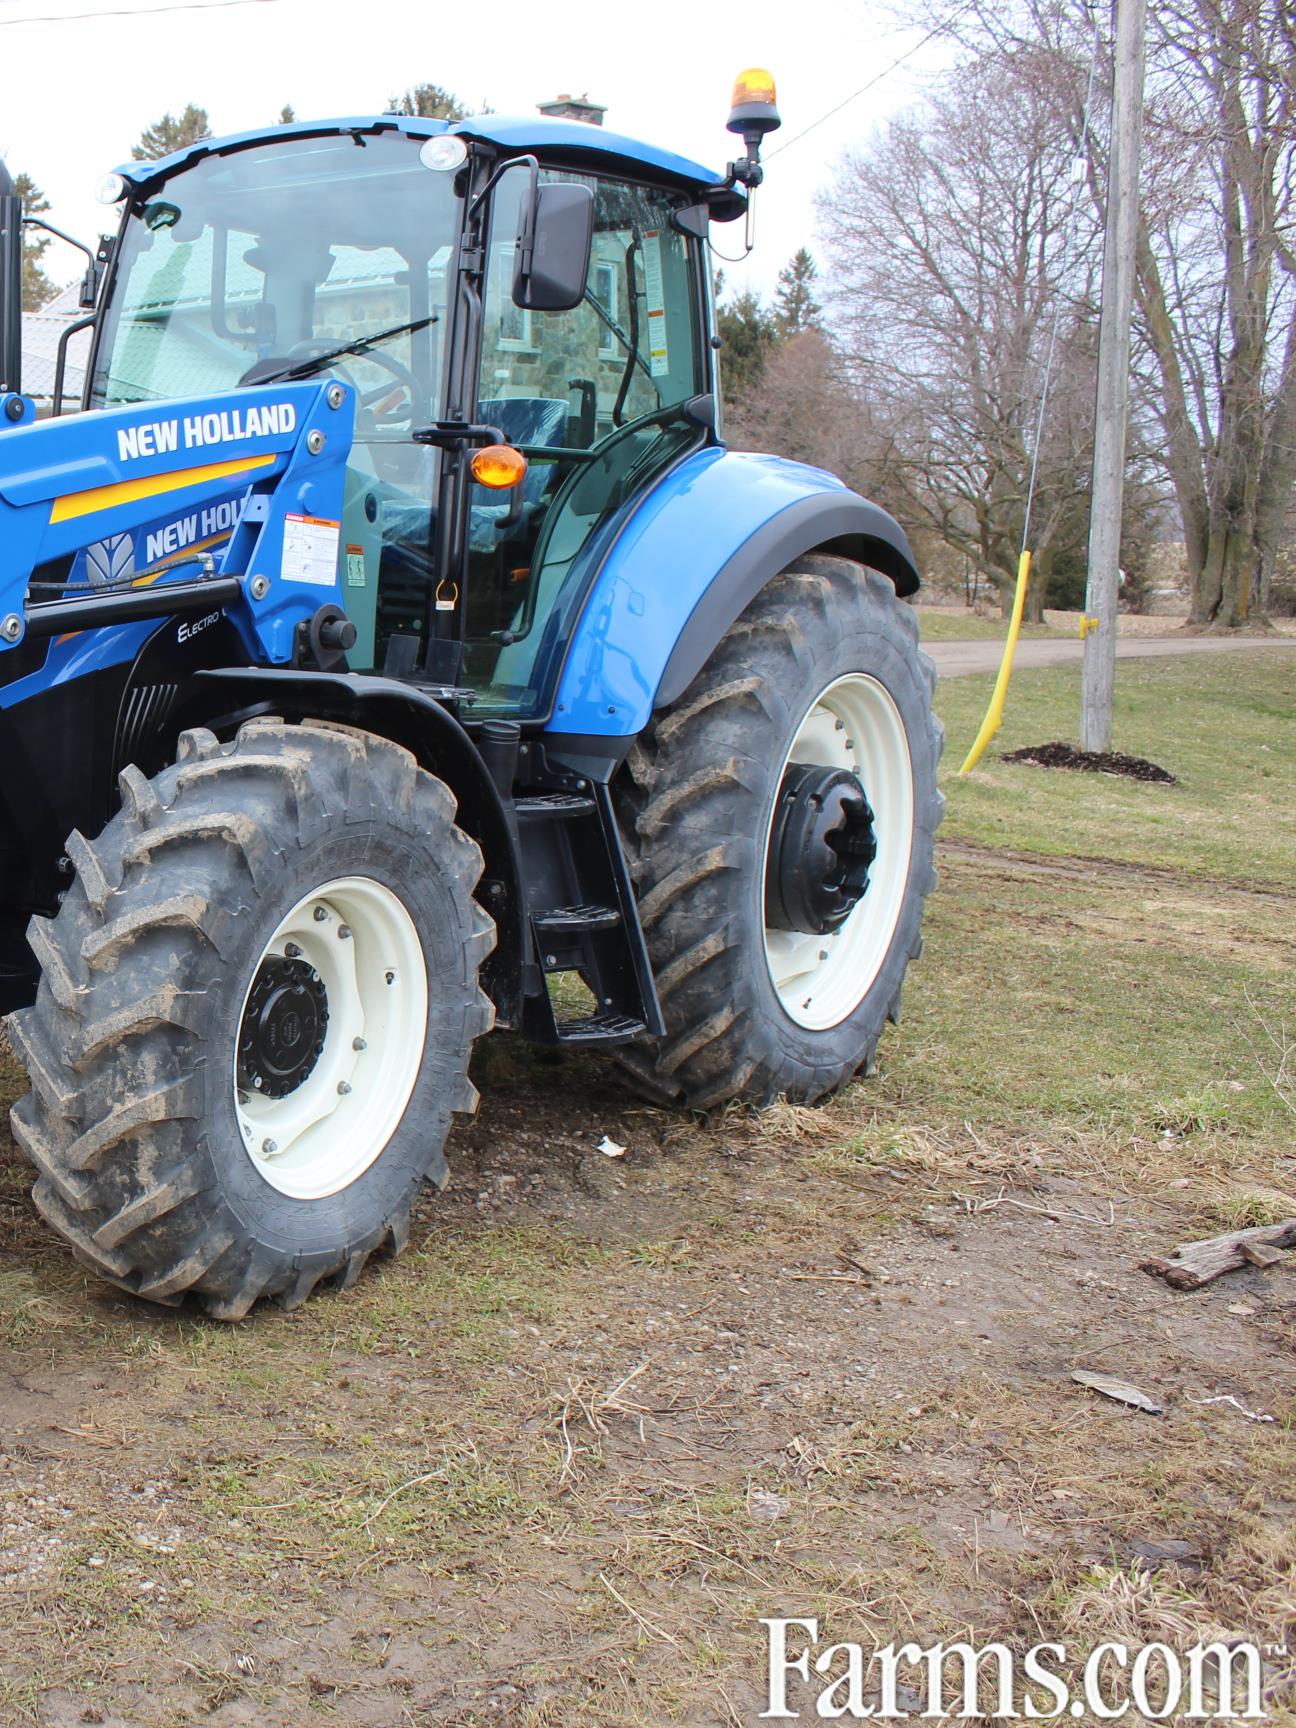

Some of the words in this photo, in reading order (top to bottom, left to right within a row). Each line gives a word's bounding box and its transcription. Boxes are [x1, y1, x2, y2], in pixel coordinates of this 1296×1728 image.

[117, 419, 178, 462] NEW
[183, 403, 296, 449] HOLLAND
[146, 513, 198, 563] NEW
